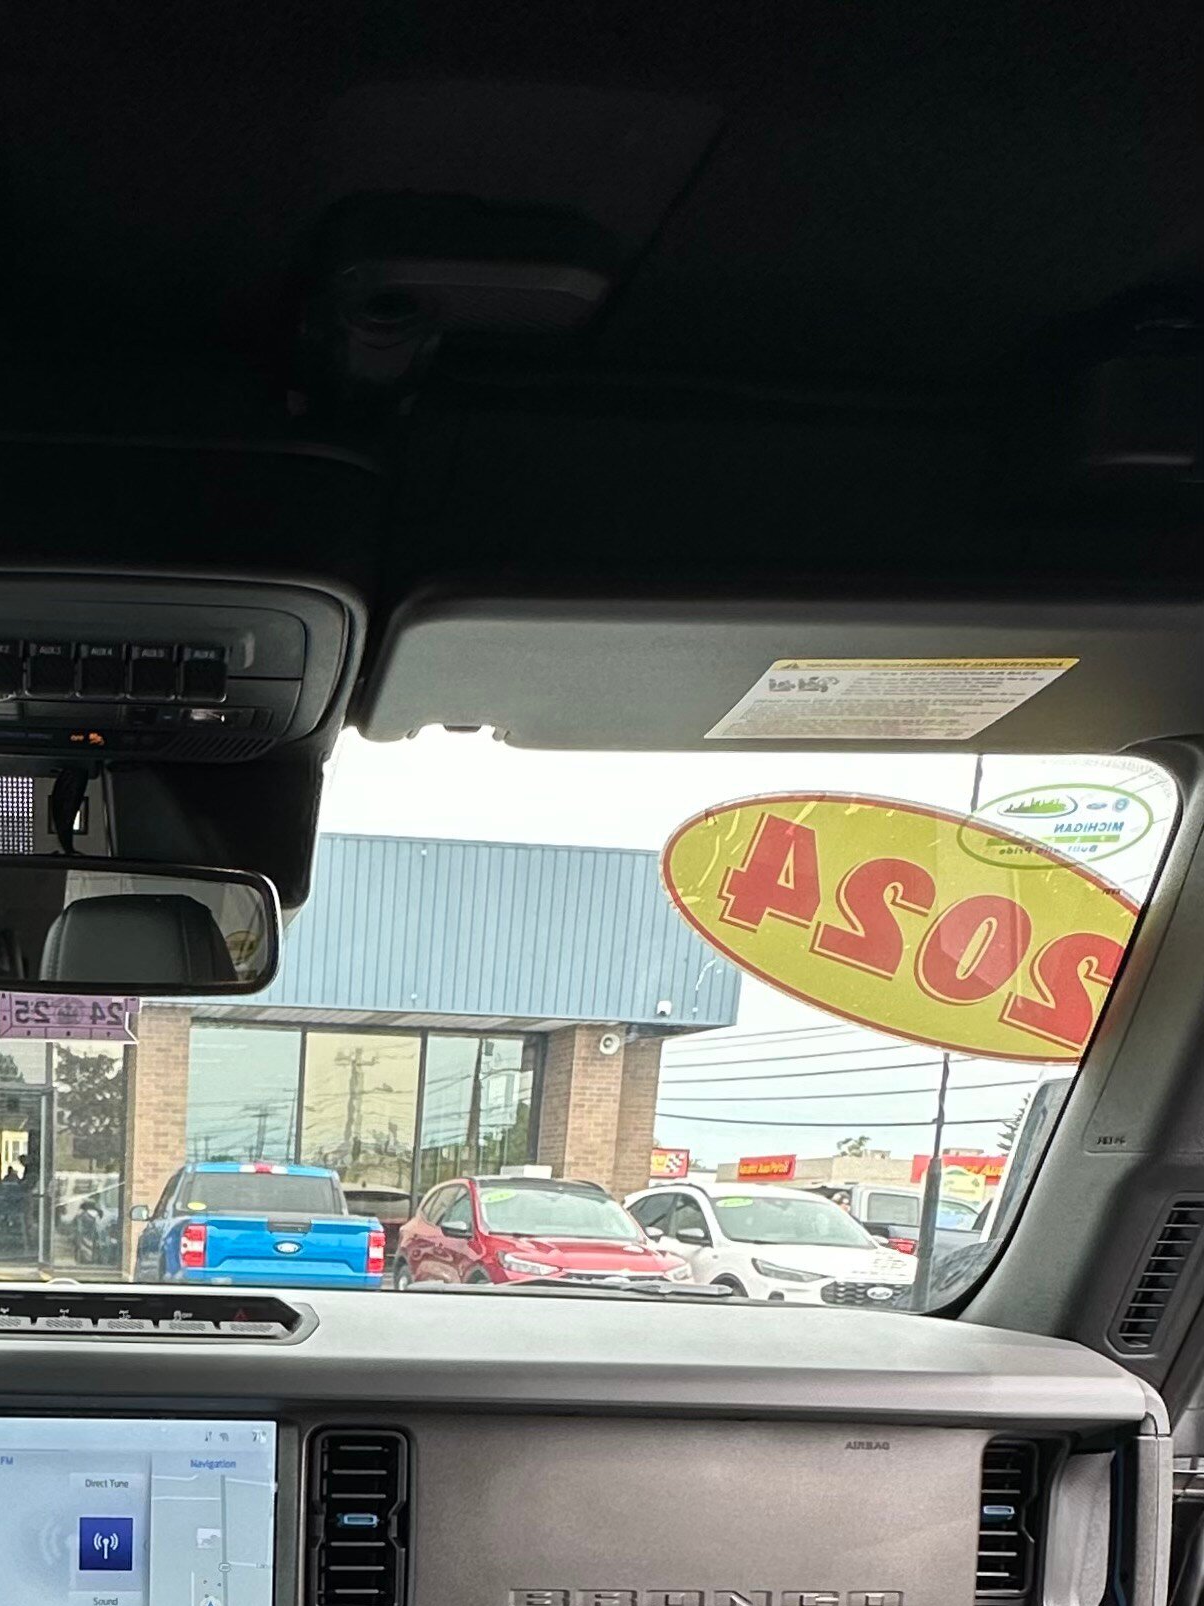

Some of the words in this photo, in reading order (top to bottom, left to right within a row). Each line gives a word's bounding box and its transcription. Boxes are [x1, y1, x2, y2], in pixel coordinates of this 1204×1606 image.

[0, 1457, 13, 1465] FM
[190, 1459, 236, 1471] Navigation
[85, 1479, 108, 1488] Direct
[110, 1480, 129, 1489] Tune
[93, 1597, 119, 1606] Sound
